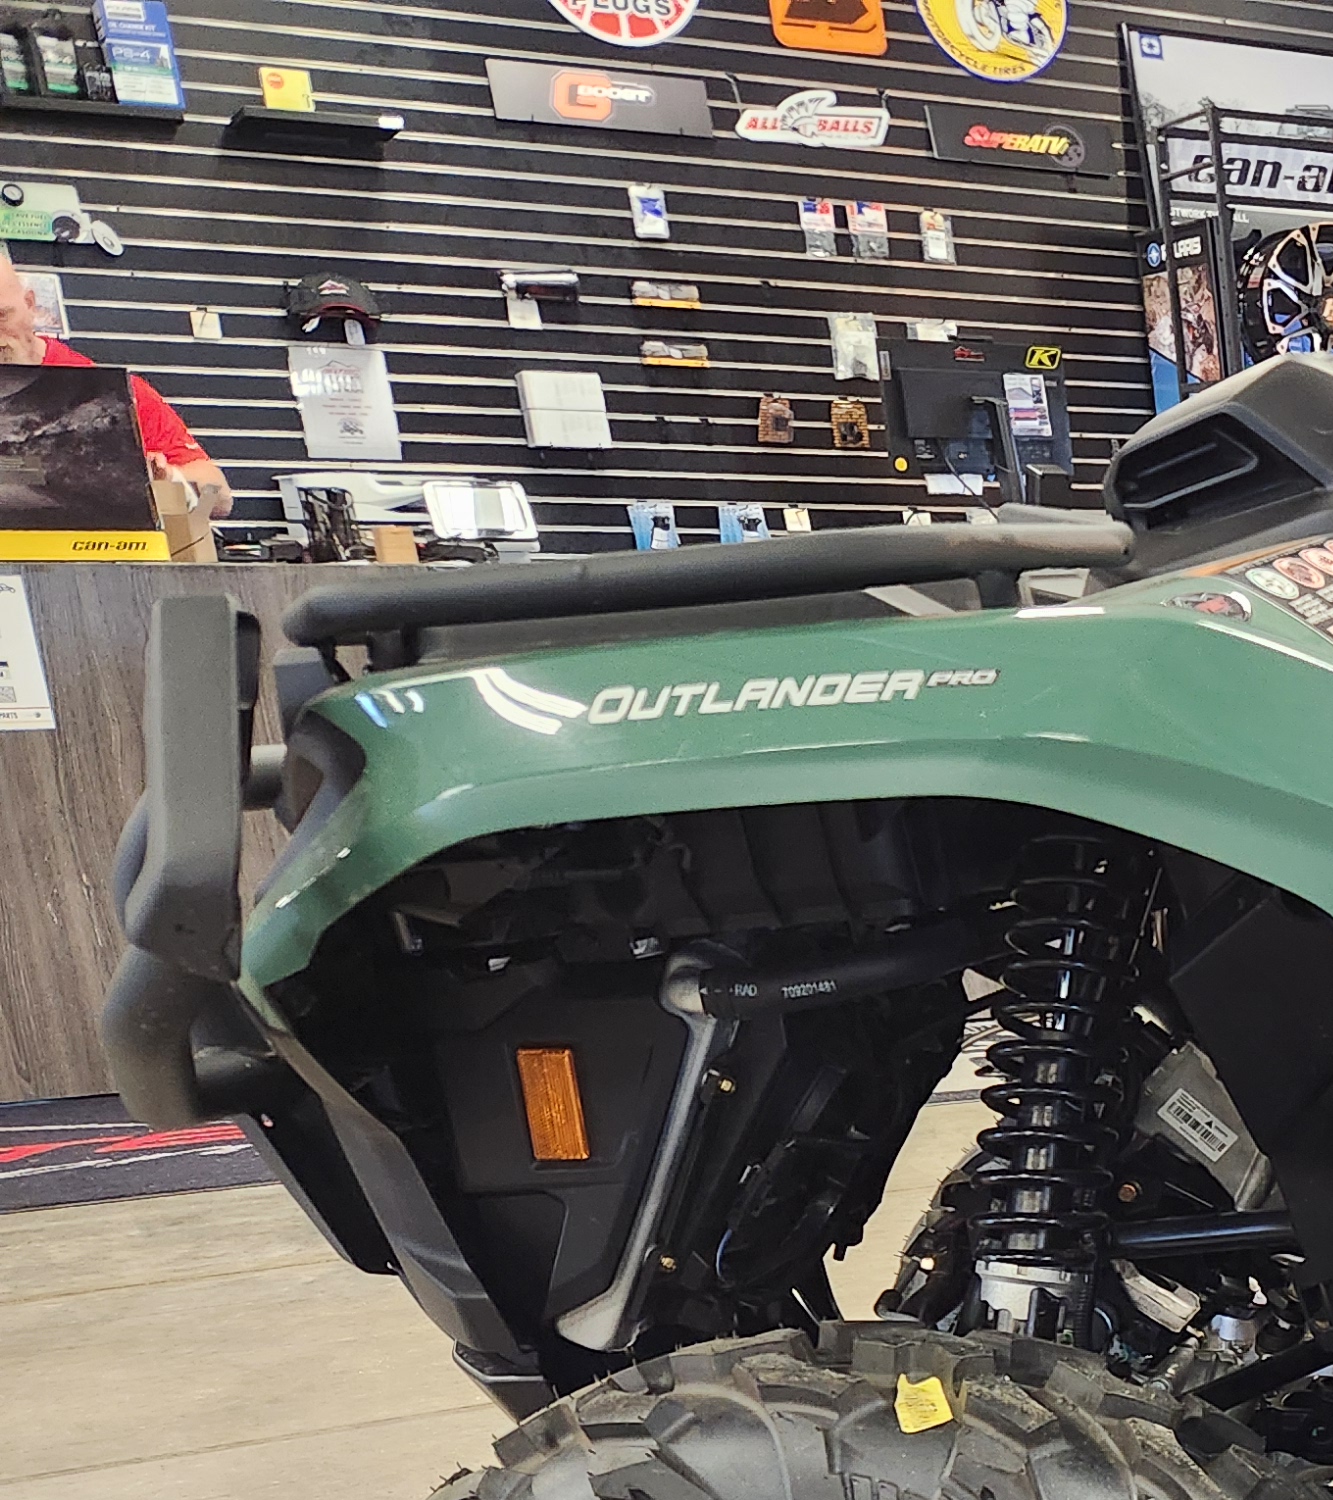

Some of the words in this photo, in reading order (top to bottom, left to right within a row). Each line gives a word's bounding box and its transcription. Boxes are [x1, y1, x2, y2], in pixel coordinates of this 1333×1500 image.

[746, 117, 779, 131] ALL
[817, 118, 874, 134] BALLS
[72, 540, 148, 552] can-am
[587, 669, 926, 724] OUTLANDER
[926, 669, 1000, 687] PRO
